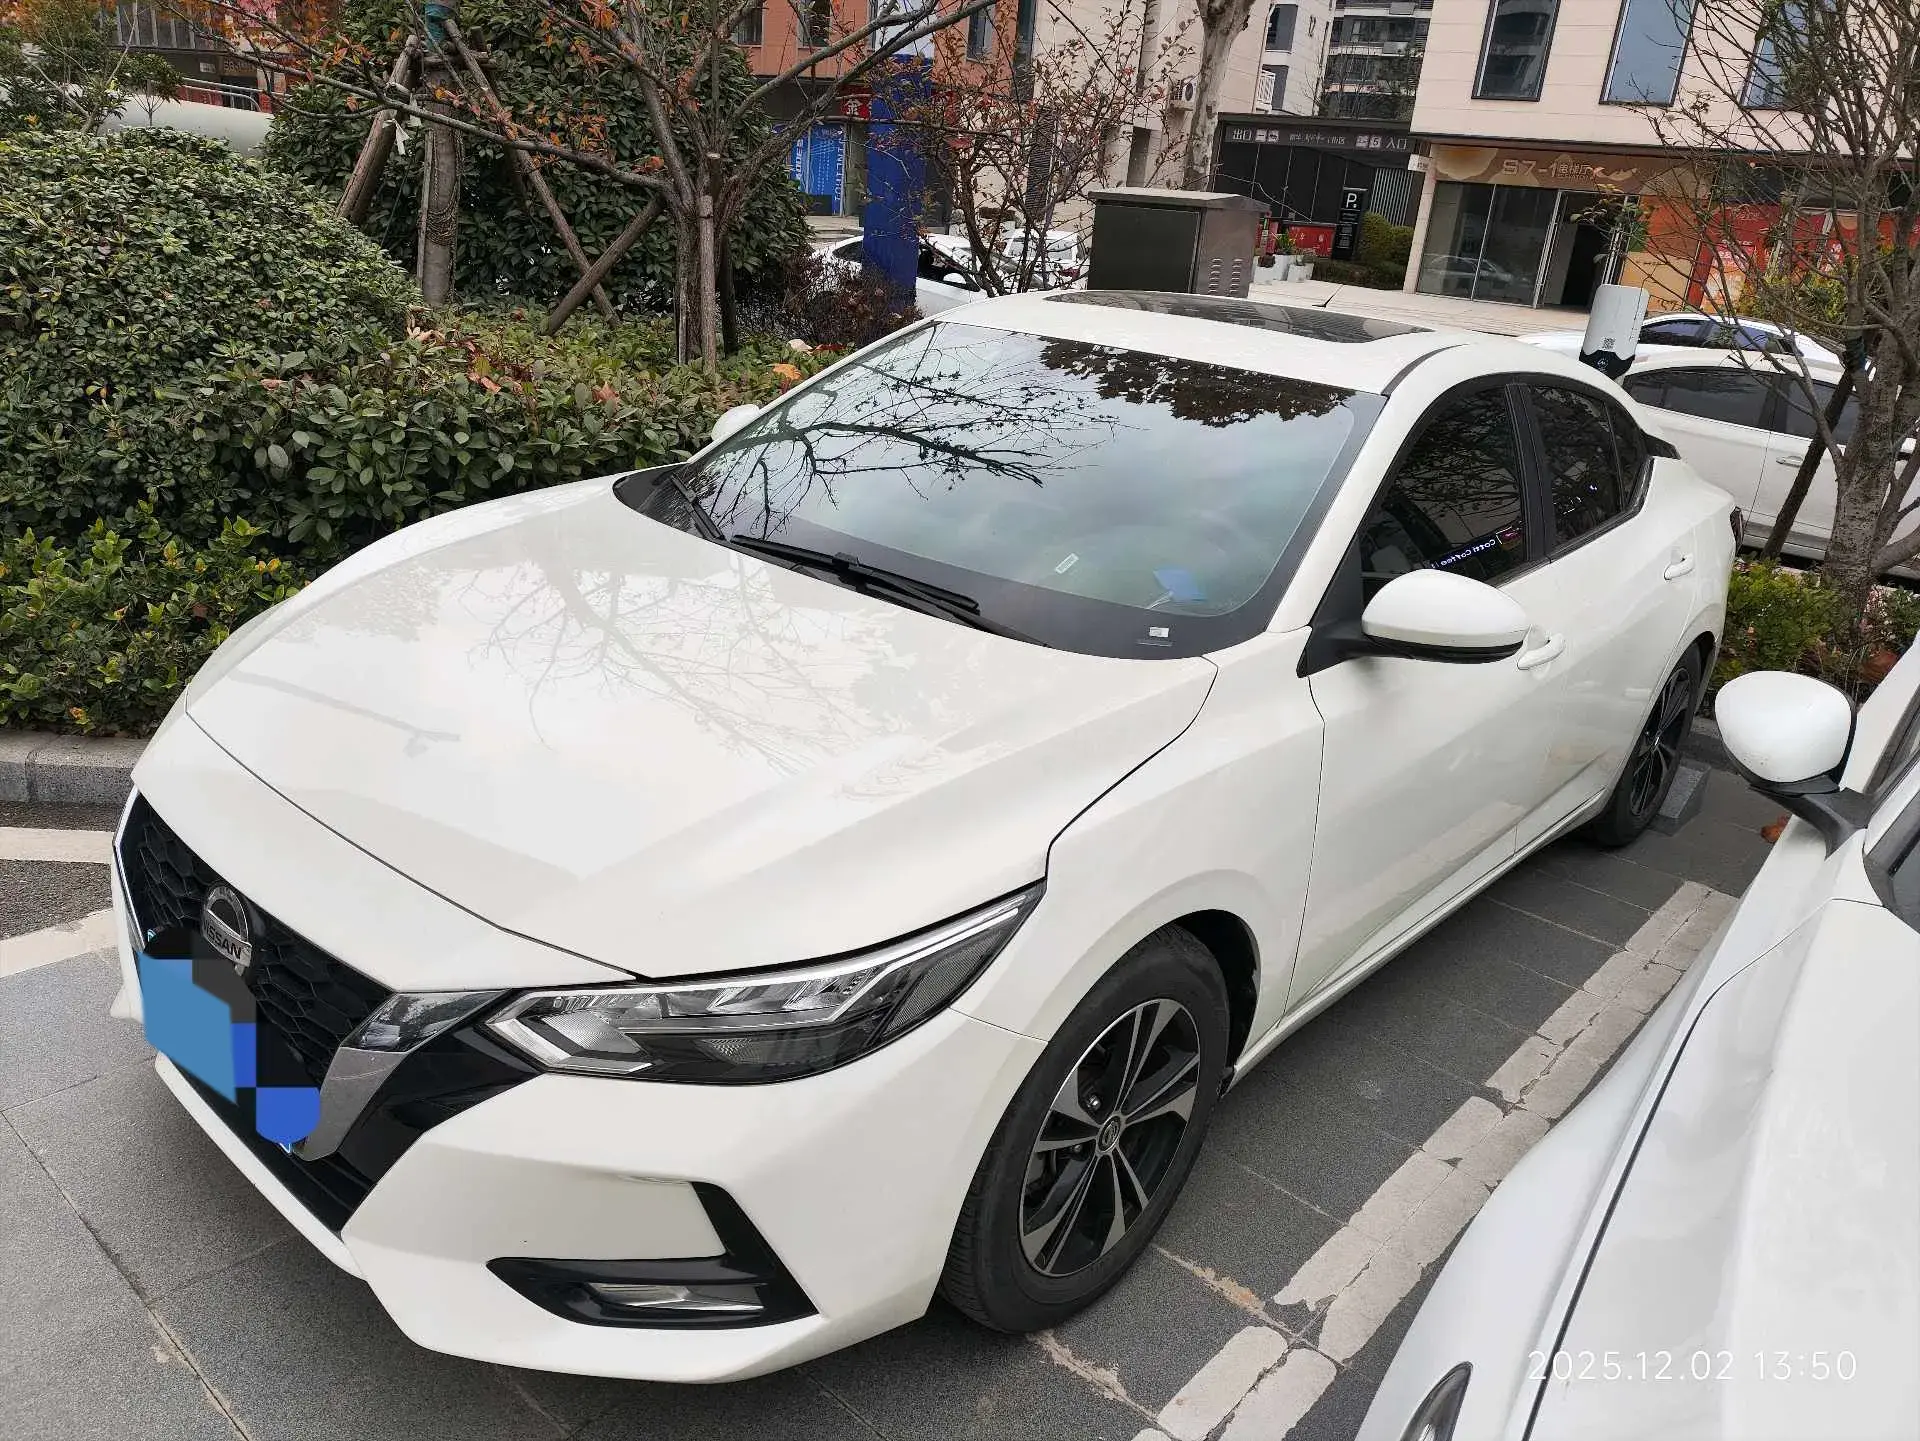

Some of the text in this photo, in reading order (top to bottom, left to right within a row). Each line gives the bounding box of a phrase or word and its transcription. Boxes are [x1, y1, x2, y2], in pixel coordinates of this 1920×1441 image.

[1232, 128, 1252, 141] 出口
[1386, 137, 1407, 150] 入口
[203, 919, 242, 960] NISSAN
